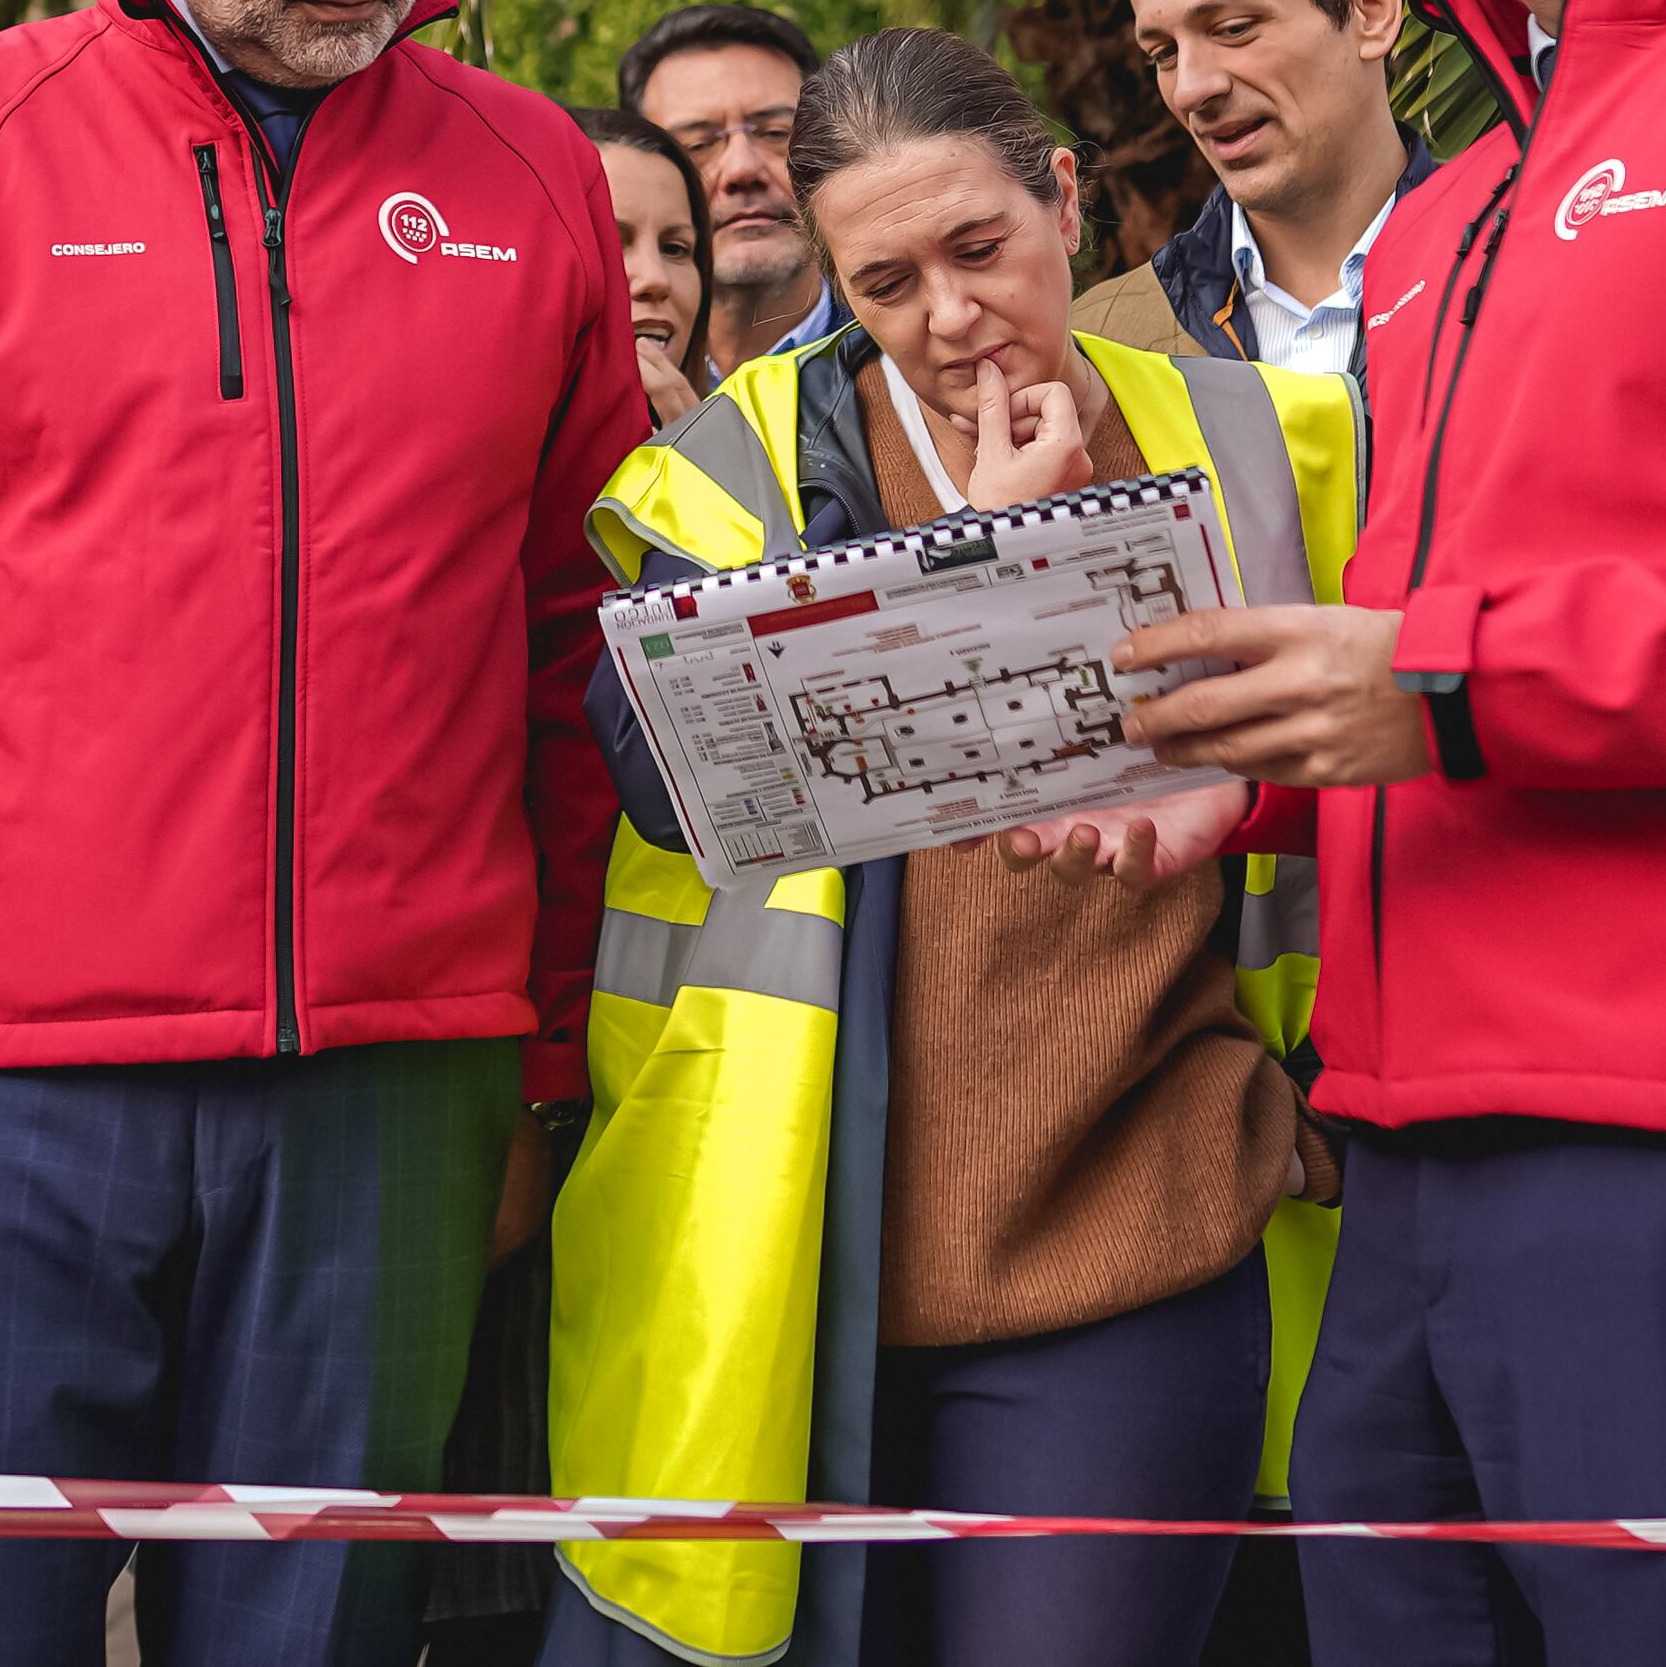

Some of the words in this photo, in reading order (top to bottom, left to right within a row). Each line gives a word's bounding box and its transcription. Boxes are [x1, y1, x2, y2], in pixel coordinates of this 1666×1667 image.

[400, 214, 428, 232] 112
[51, 242, 145, 256] CONSEJERO
[440, 243, 518, 262] ASEM
